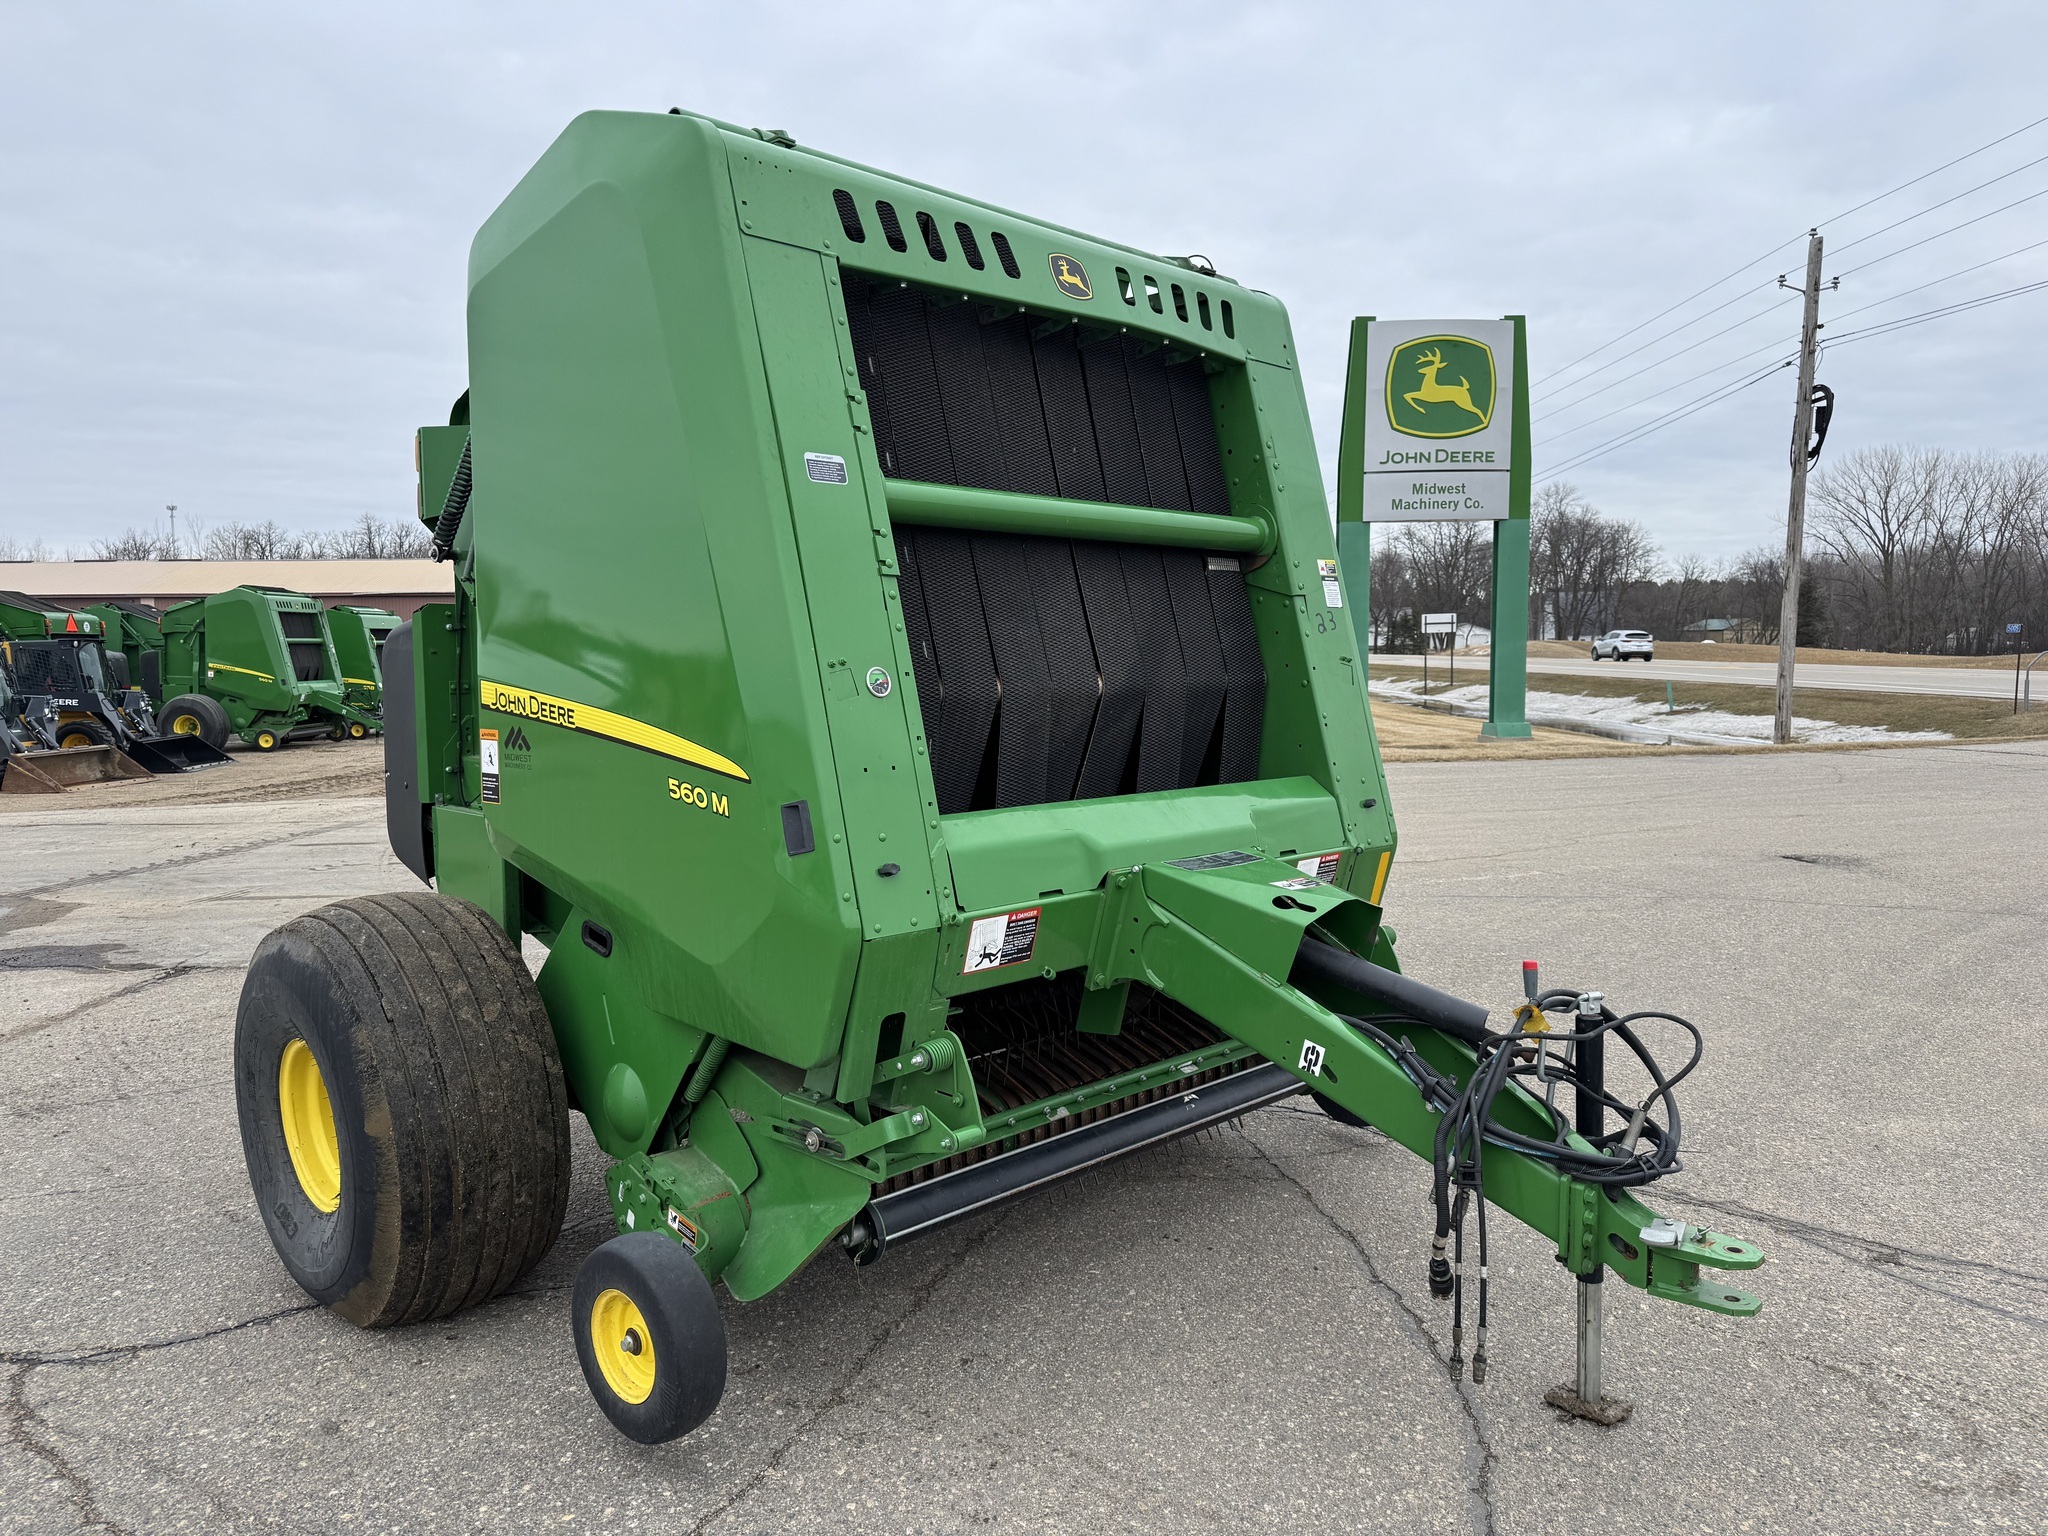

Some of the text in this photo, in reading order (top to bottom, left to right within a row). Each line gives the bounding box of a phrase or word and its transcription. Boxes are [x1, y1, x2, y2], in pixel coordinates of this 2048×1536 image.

[1379, 448, 1496, 465] JOHN DEERE
[1411, 482, 1466, 495] Midwest
[1391, 497, 1484, 511] Machinery Co.
[1315, 610, 1337, 634] 23
[490, 687, 576, 726] JOHN DEERE
[504, 752, 532, 764] MIDWEST
[667, 776, 730, 819] 560 M
[1017, 910, 1038, 919] DANGER
